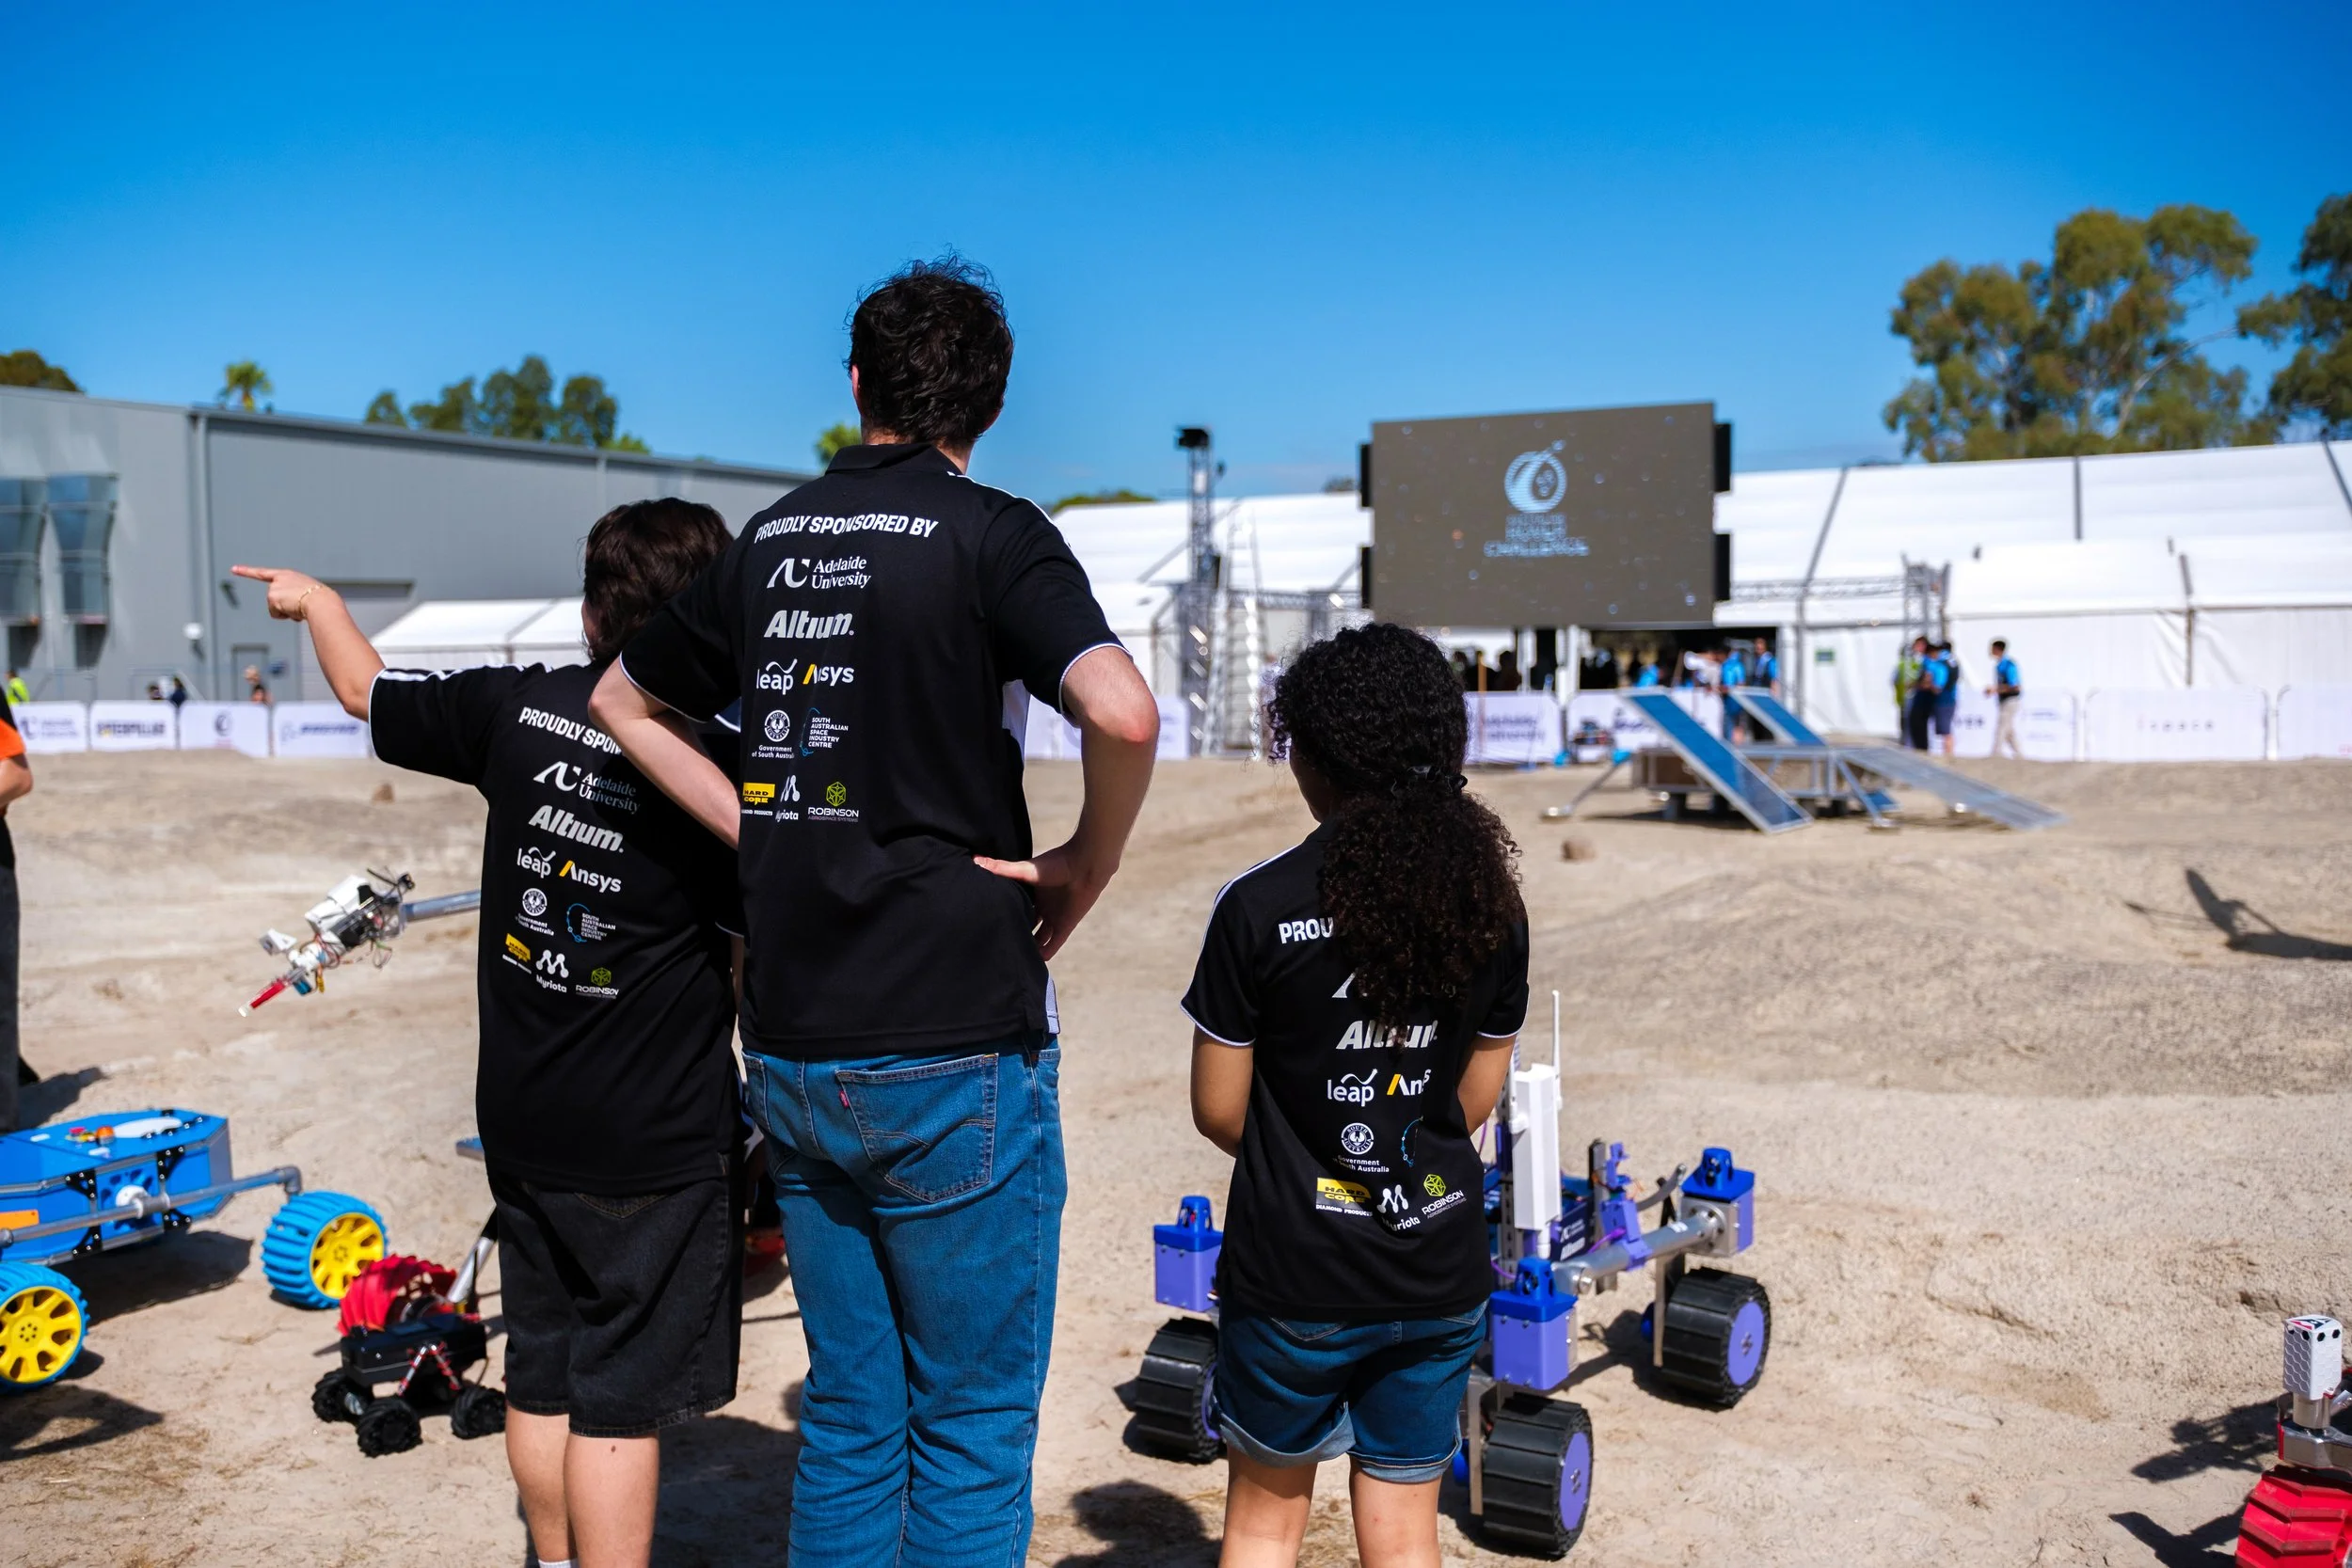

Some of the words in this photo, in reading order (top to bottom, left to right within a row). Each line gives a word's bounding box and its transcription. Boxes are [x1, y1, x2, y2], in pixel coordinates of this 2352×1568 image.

[754, 515, 812, 544] PROUDLY
[808, 514, 909, 535] SPONSORED
[909, 517, 939, 538] BY
[813, 556, 867, 574] Adelaide
[811, 572, 872, 590] University
[755, 669, 794, 696] leap
[518, 706, 586, 741] PROUDLY
[810, 723, 849, 732] AUSTRALIAN
[758, 744, 792, 752] Government
[581, 772, 637, 798] Adelaide
[579, 783, 641, 815] University
[743, 796, 769, 806] CORE
[807, 806, 860, 818] ROBINSON
[516, 847, 552, 879] leap
[559, 860, 623, 894] Ansys
[1278, 916, 1334, 944] PROU
[535, 974, 567, 993] Myriota
[1327, 1079, 1375, 1107] leap
[1346, 1125, 1369, 1133] SOUTH
[1324, 1193, 1366, 1205] CORE
[1325, 1186, 1365, 1196] HARD
[1315, 1204, 1343, 1213] DIAMOND
[1421, 1189, 1465, 1215] ROBINSON
